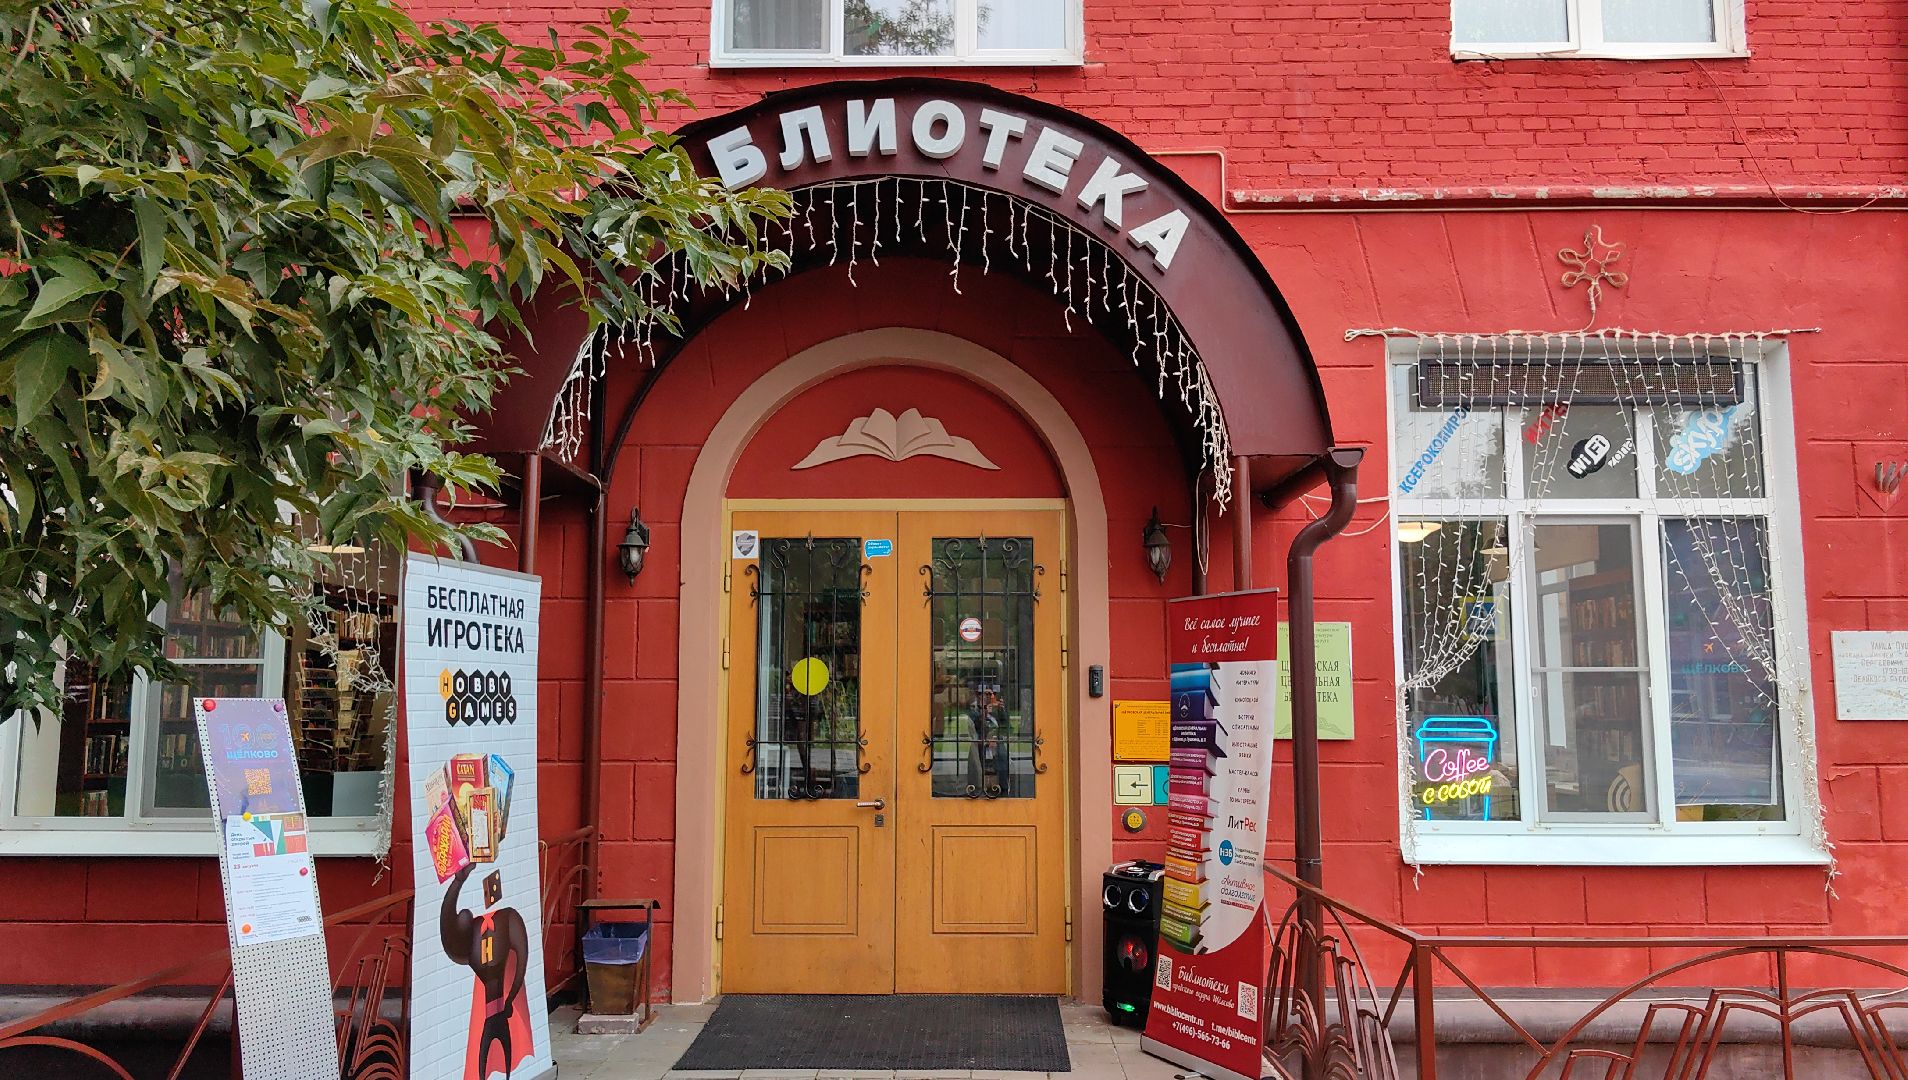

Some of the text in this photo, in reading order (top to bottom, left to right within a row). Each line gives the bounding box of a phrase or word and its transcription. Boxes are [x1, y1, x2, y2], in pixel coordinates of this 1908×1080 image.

[592, 97, 1191, 273] БЛИОТЕКА
[1399, 405, 1471, 493] КСЕРОКОПИРО
[428, 586, 524, 619] БЕСПЛАТНАЯ
[428, 617, 525, 653] ИГРОТЕКА
[1229, 615, 1260, 634] лучшее
[1202, 635, 1249, 653] бесплатно!
[1281, 660, 1339, 672] ЩСКАЯ
[442, 676, 510, 694] HOBBY
[1284, 691, 1339, 702] БТЕКА
[448, 701, 515, 719] GAMES
[456, 763, 475, 775] CATAN
[1424, 748, 1490, 782] Coffee
[1437, 775, 1492, 802] собой
[1227, 816, 1257, 832] ЛитРес
[1178, 966, 1229, 995] Библиотеки
[1153, 1000, 1205, 1027] www.bibliocentr.ru
